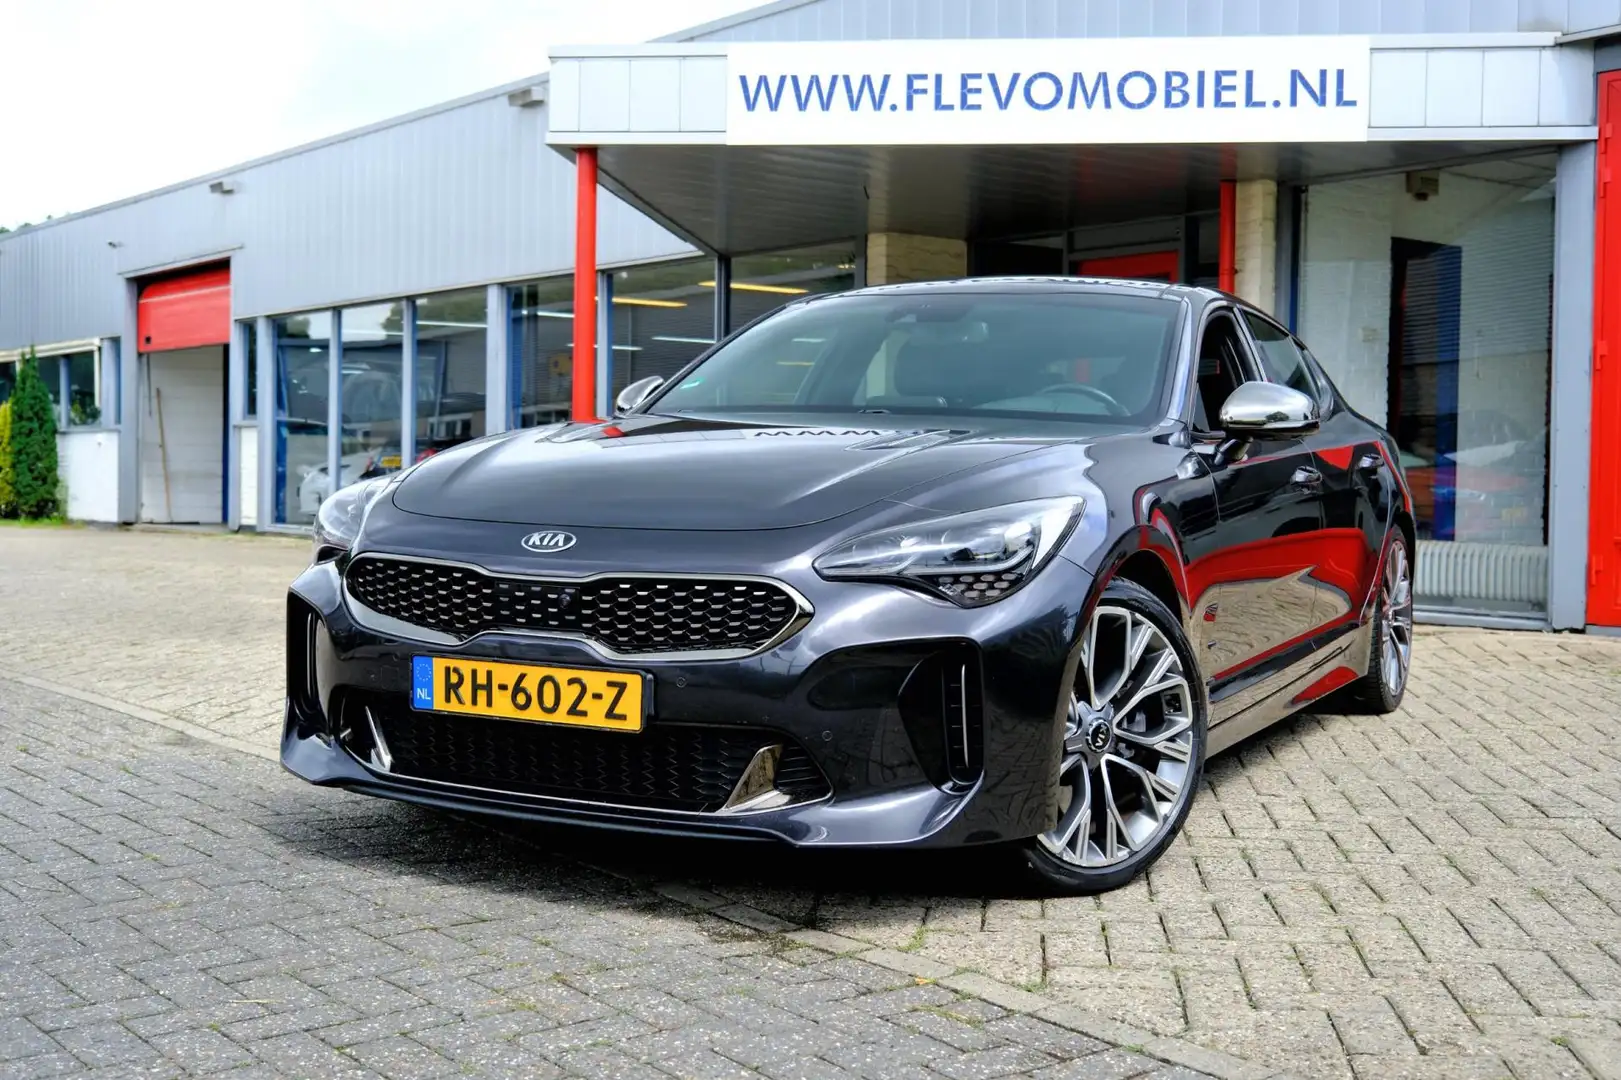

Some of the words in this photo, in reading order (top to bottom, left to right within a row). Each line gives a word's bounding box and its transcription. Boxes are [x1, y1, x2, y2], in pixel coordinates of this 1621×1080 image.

[740, 69, 1357, 112] WWW.FLEVOMOBIEL.NL
[417, 689, 431, 700] NL
[444, 666, 628, 721] RH-602-Z
